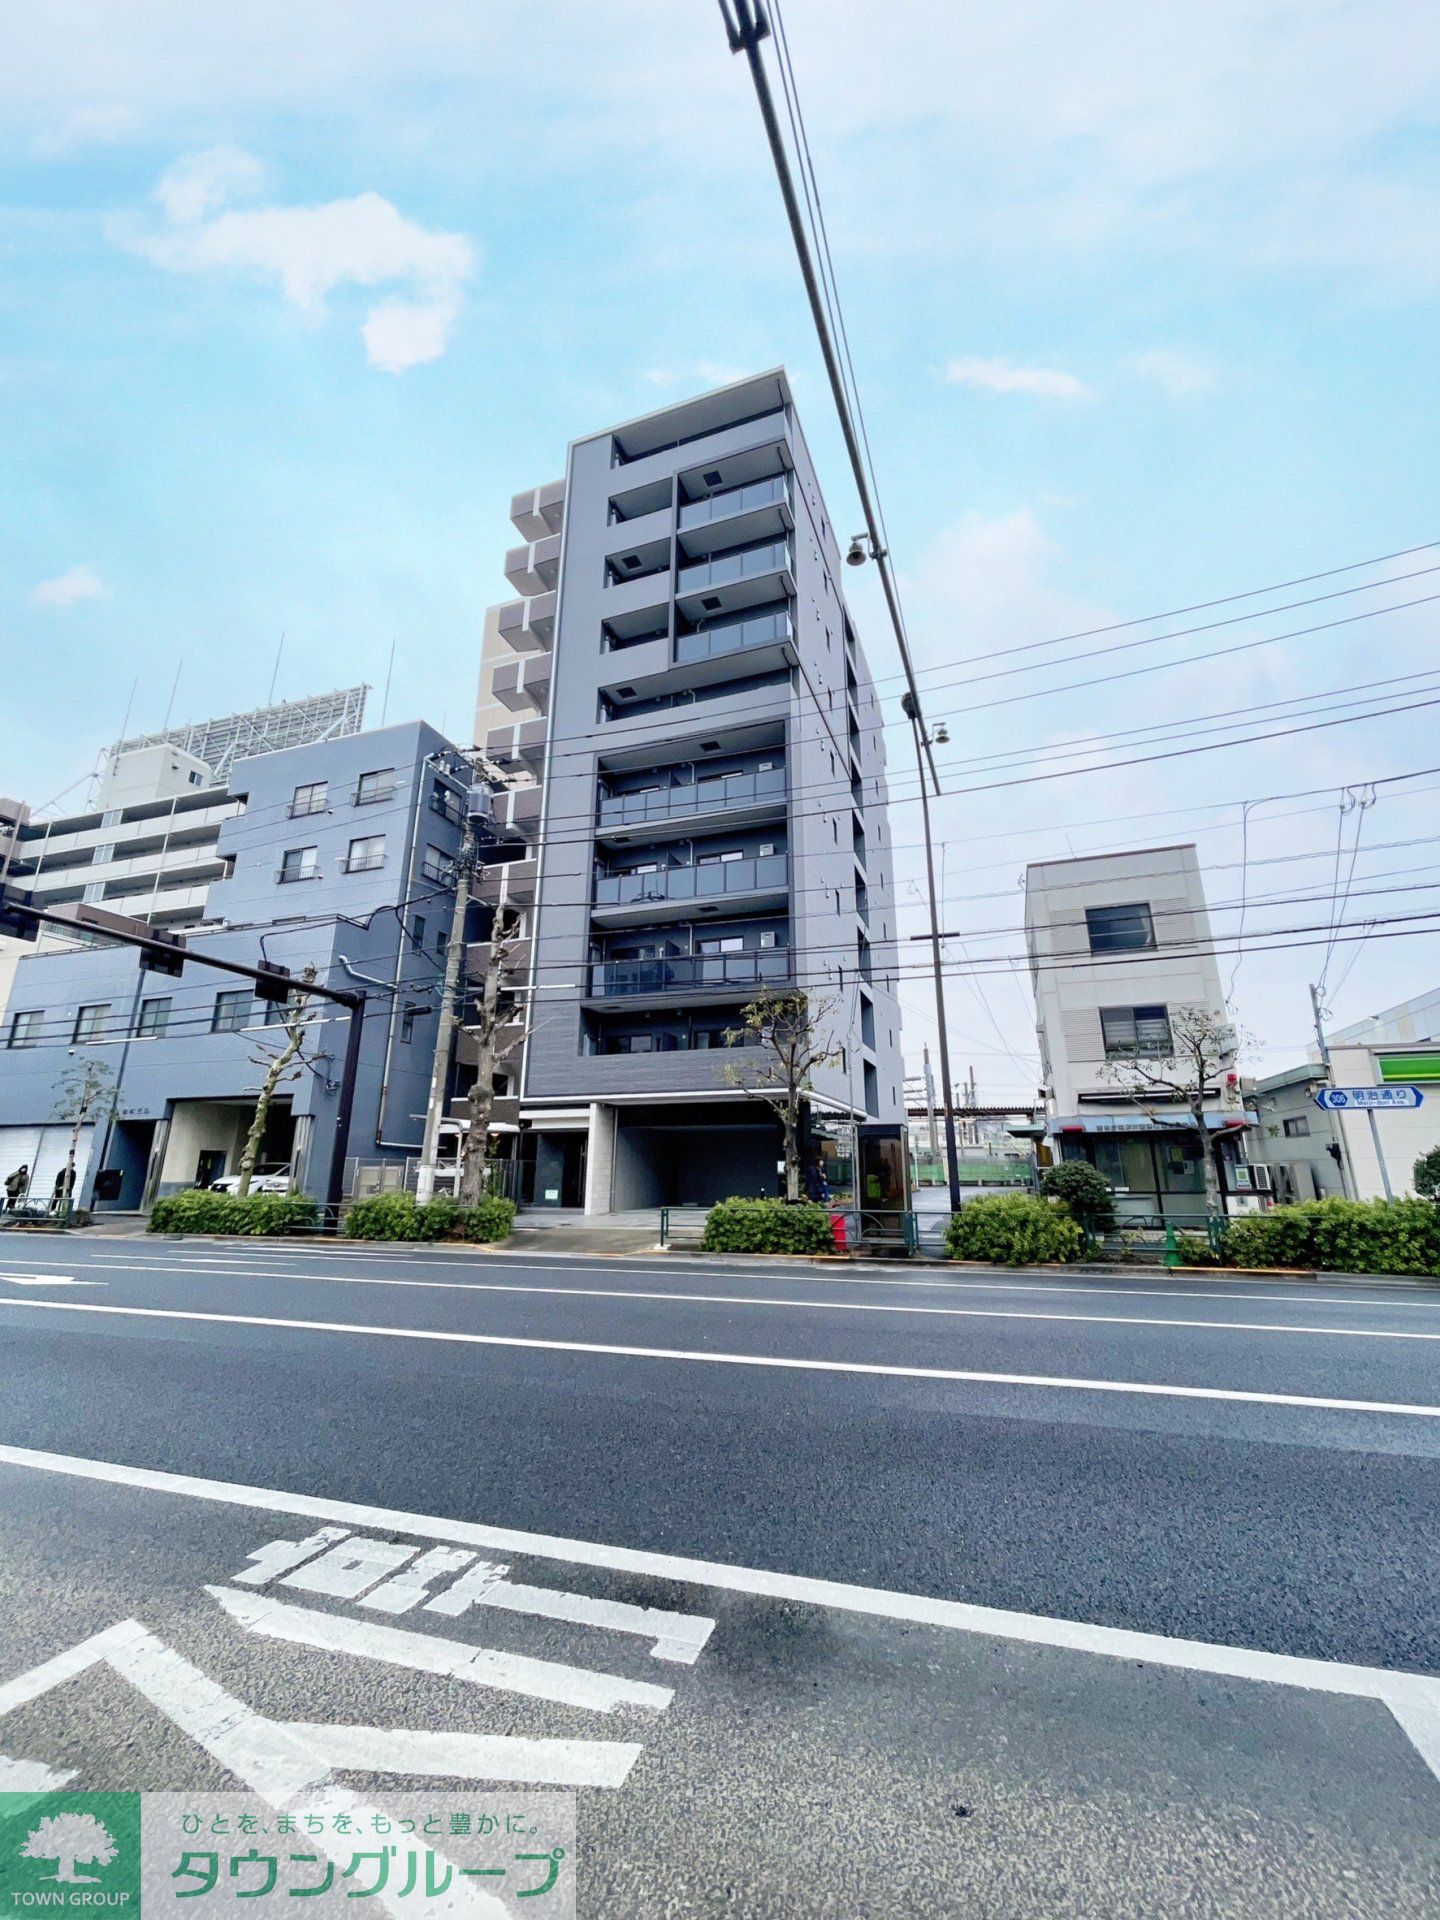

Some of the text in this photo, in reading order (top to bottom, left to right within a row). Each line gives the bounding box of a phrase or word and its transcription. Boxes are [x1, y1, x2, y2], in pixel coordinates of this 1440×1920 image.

[1331, 1094, 1346, 1104] 306
[1352, 1089, 1407, 1101] 明治通り
